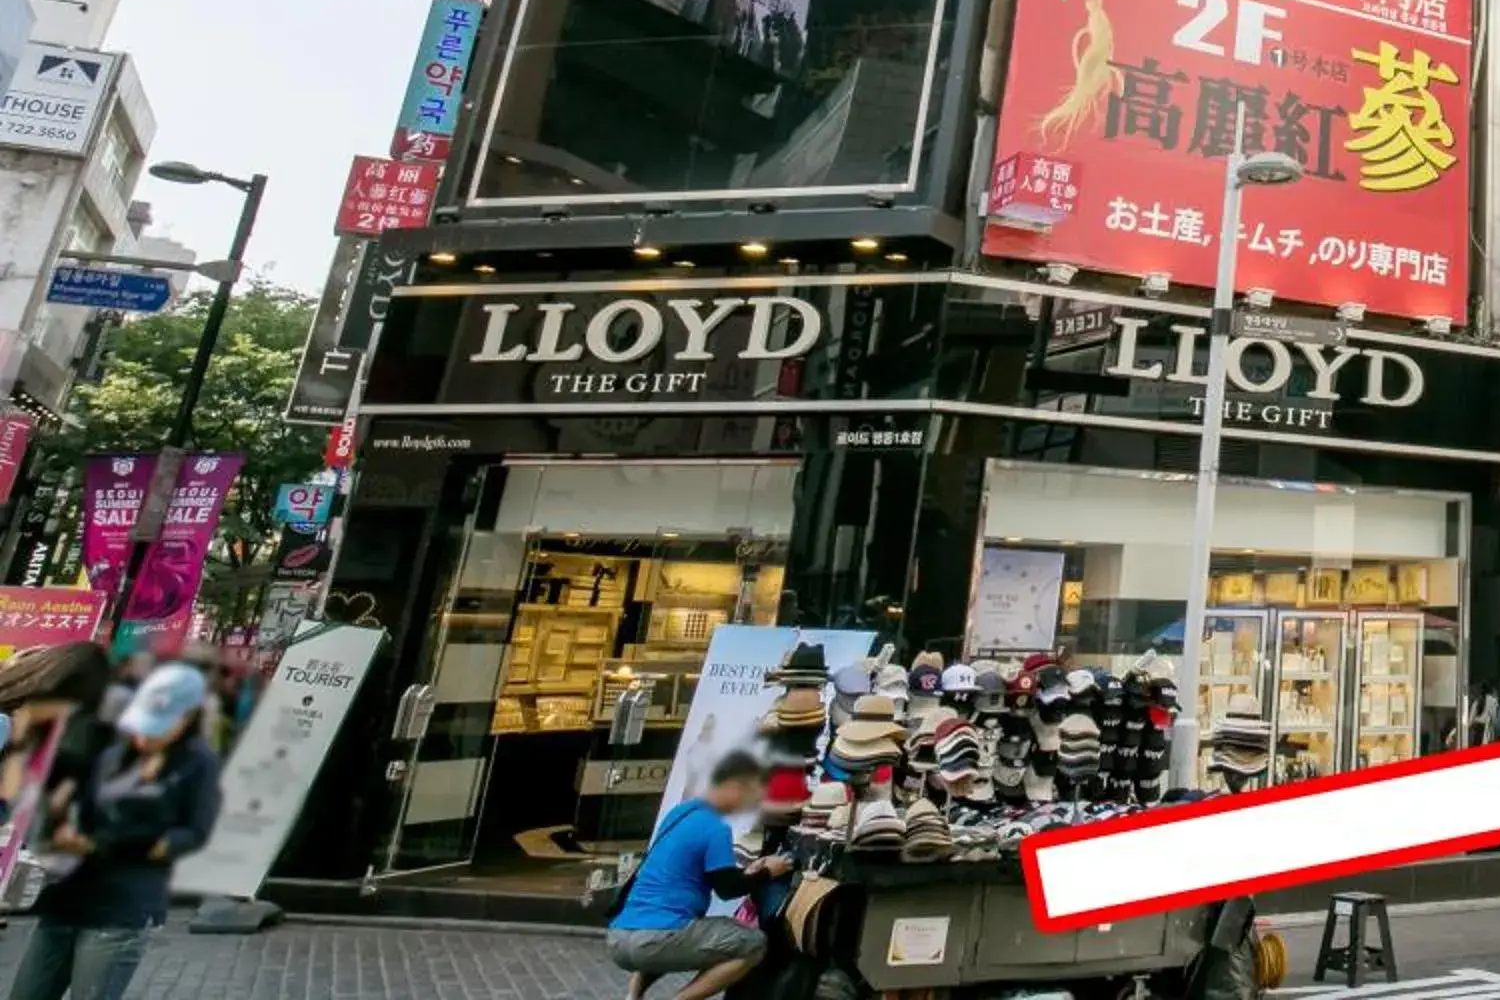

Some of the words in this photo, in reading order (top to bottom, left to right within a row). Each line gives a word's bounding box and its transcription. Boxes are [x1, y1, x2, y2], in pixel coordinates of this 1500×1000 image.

[419, 7, 471, 125] 푸른약국
[470, 296, 824, 363] LLOYD
[1106, 316, 1425, 408] LLOYD
[551, 373, 616, 394] THE
[624, 371, 707, 394] GIFT
[1261, 404, 1334, 431] GIFT
[288, 487, 325, 521] 약
[285, 667, 354, 689] TOURIST
[709, 663, 748, 679] BEST
